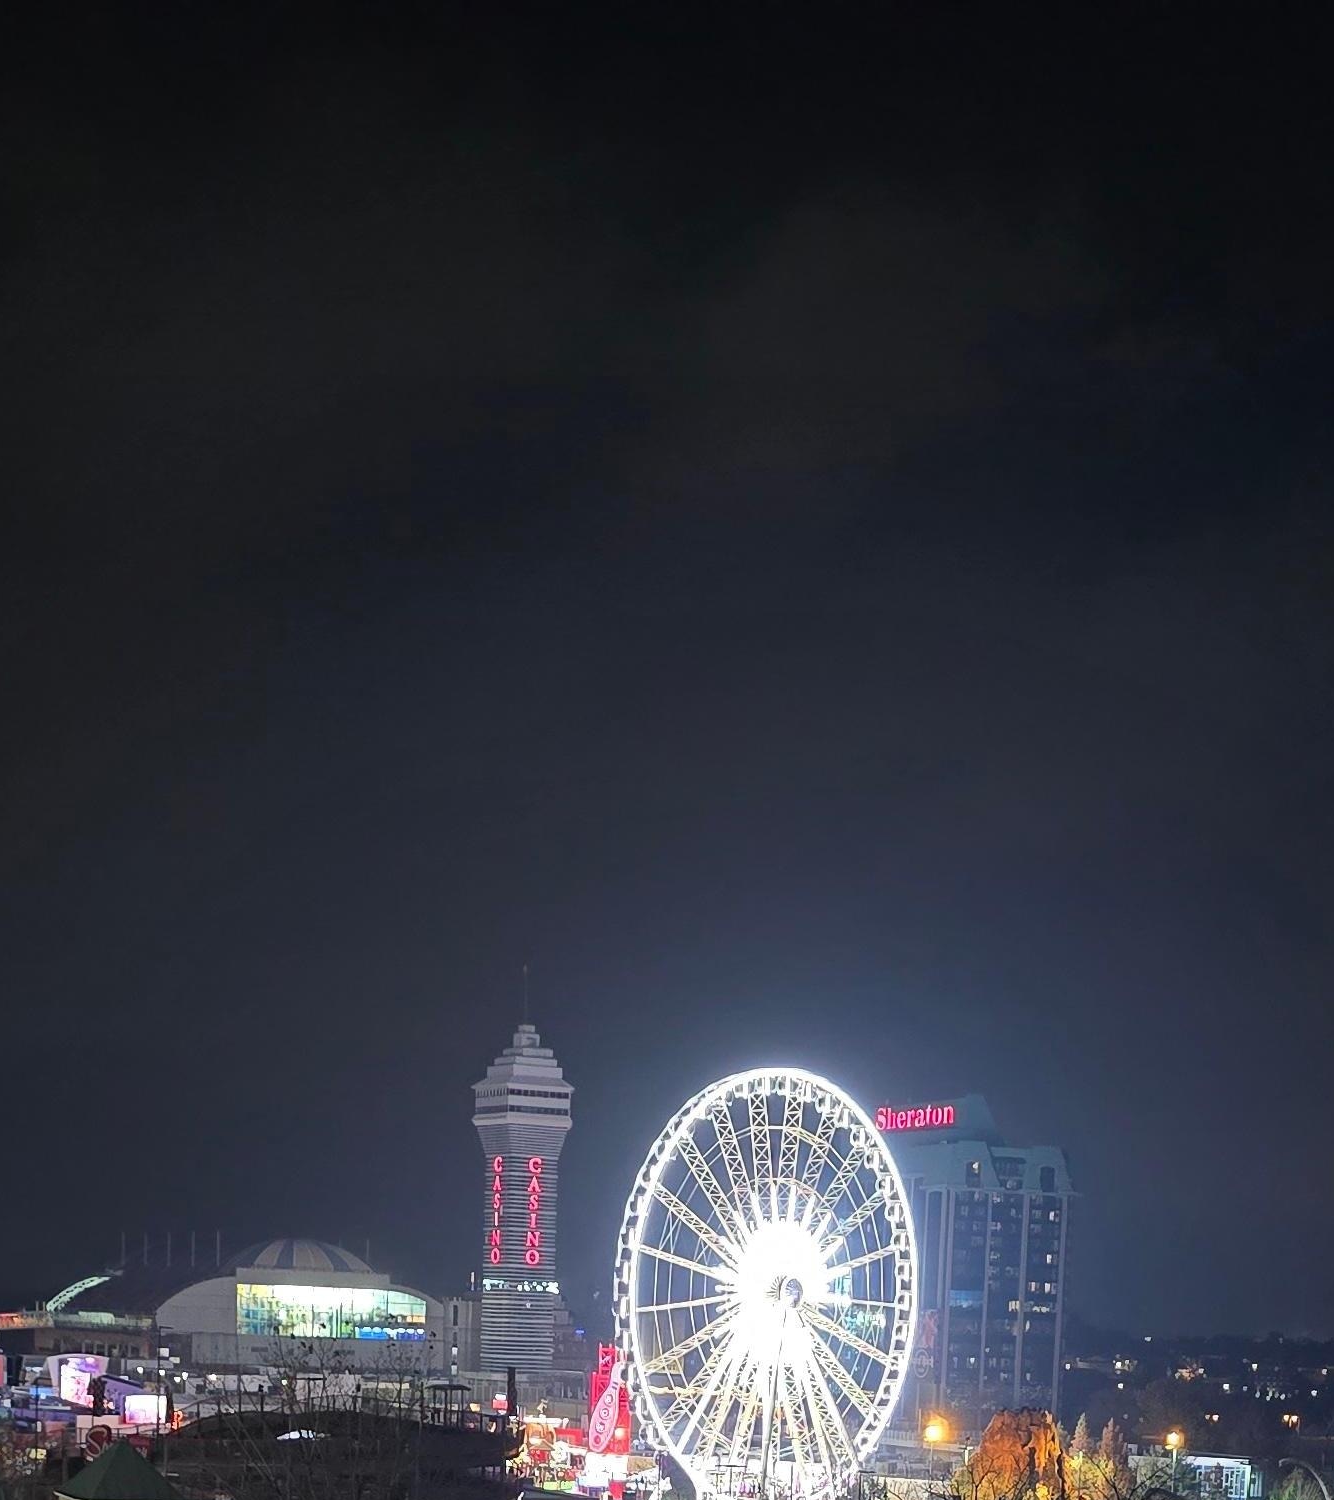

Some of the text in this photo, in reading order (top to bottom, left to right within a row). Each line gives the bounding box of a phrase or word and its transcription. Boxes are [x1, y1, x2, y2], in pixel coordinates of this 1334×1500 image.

[875, 1104, 954, 1130] Sheraton
[490, 1156, 503, 1264] CASINO
[524, 1157, 542, 1265] CASINO
